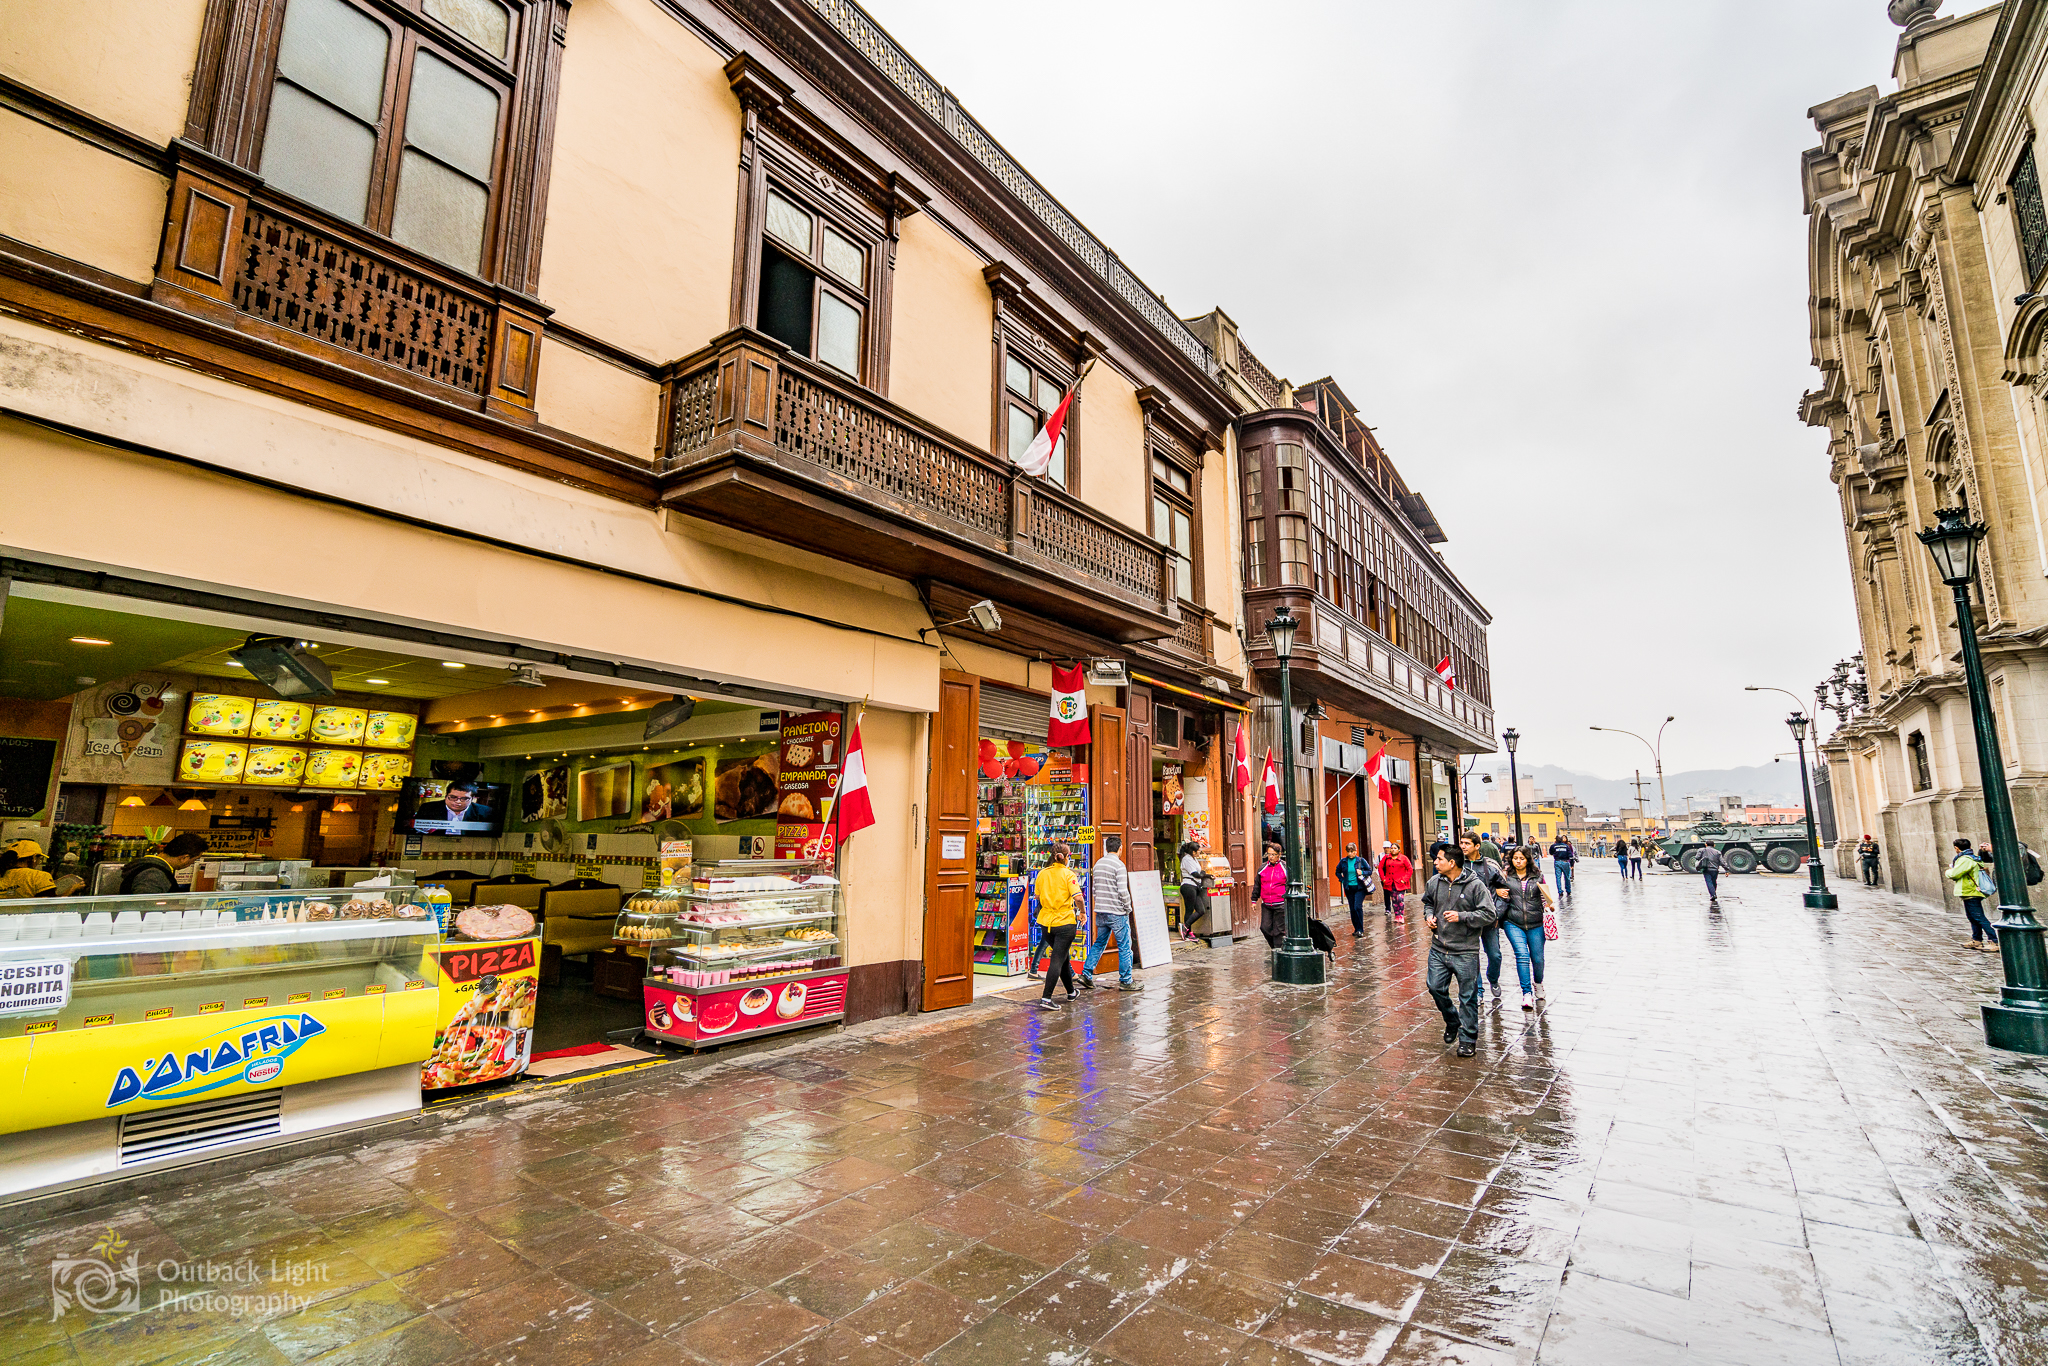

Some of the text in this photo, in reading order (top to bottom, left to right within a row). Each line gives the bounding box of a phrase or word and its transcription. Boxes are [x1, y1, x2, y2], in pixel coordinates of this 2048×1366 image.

[783, 720, 828, 737] PANETON
[786, 736, 814, 744] CHOCOLATE
[86, 741, 163, 756] Ice Cream
[780, 770, 826, 782] EMPANADA
[777, 825, 808, 838] PIZZA
[1011, 932, 1028, 942] Agente
[450, 944, 532, 978] PIZZA
[1, 980, 63, 997] ÑORITA
[147, 1009, 172, 1018] CHICLE
[26, 1022, 57, 1031] MENTA
[106, 1013, 326, 1107] D'ANAFRIA
[252, 1058, 278, 1067] HELADOS
